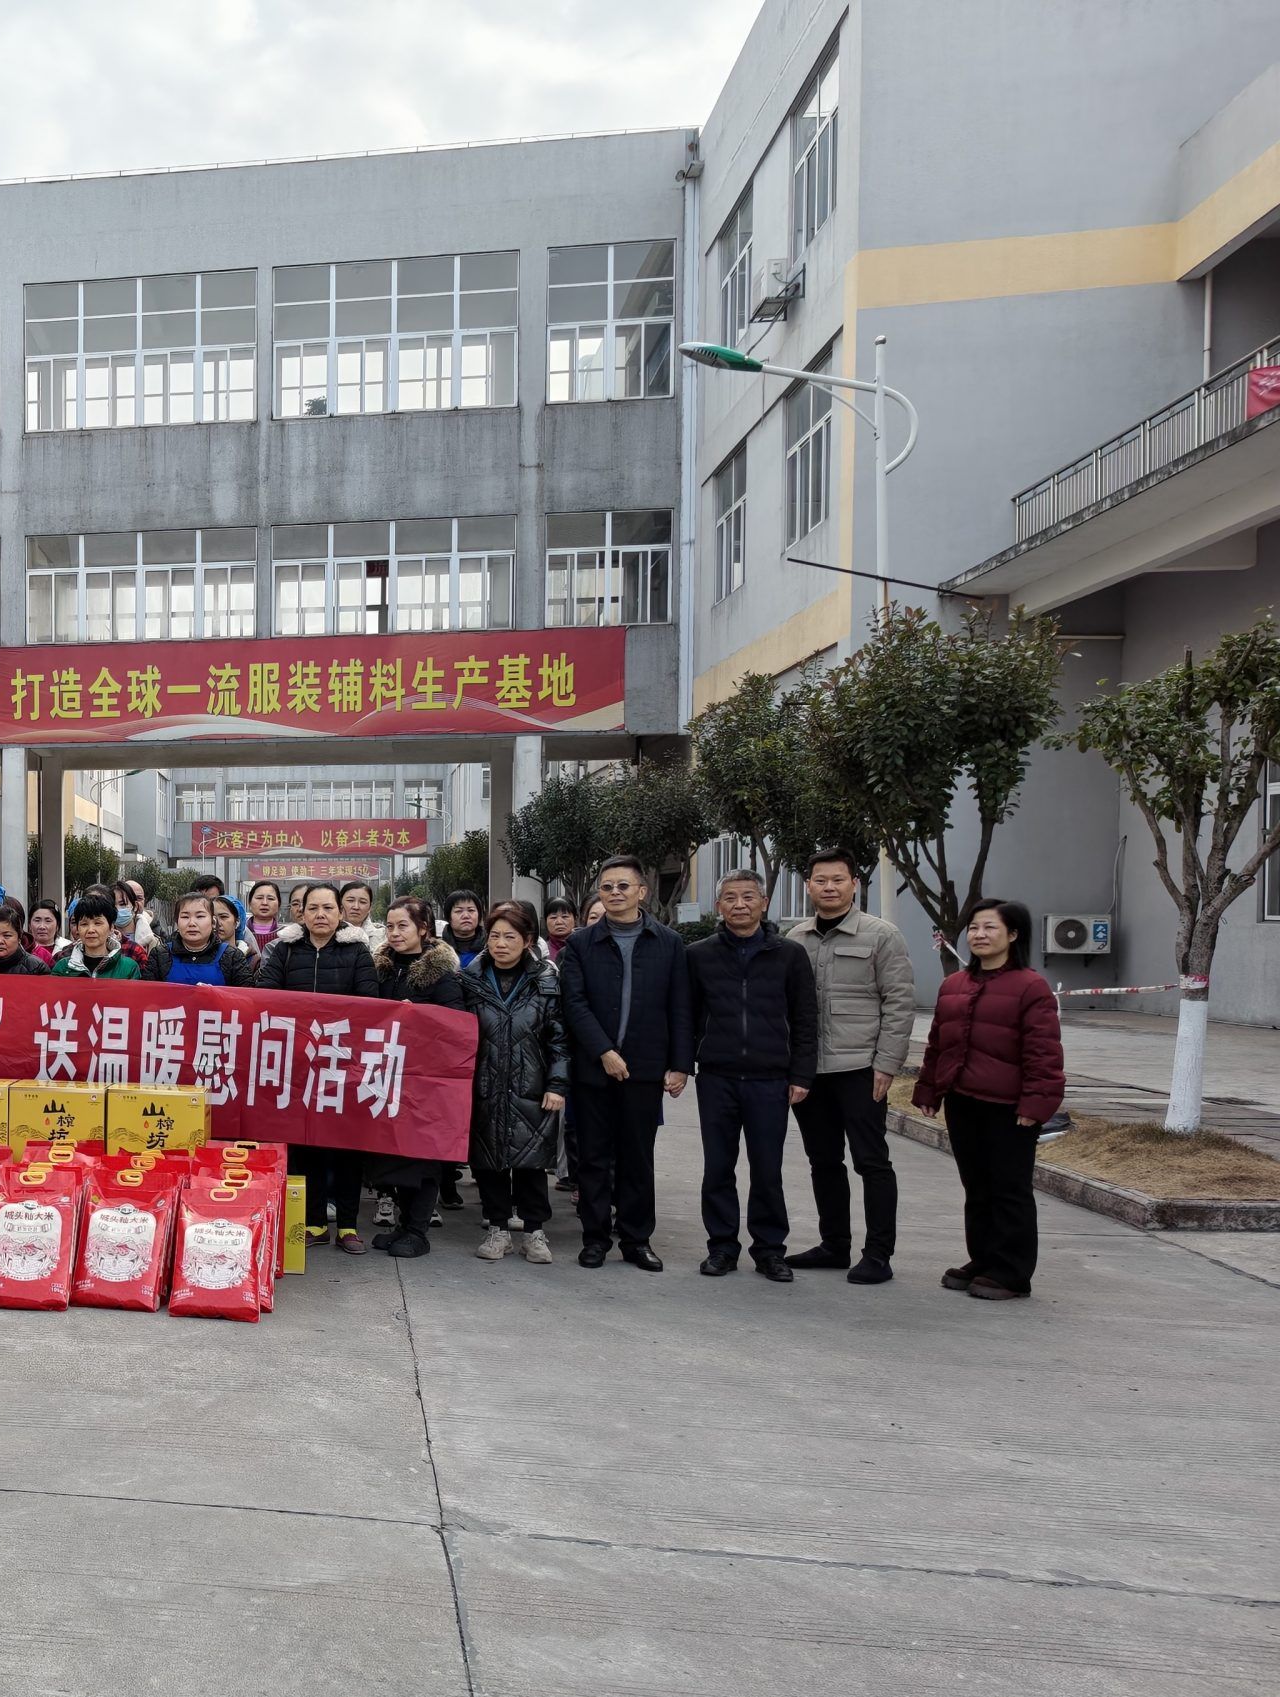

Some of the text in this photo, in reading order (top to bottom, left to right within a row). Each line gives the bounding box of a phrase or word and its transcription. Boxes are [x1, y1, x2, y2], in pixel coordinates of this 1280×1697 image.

[11, 653, 577, 721] 打造全球一流服装辅料生产基地
[216, 828, 410, 849] 以客户为中心 以奋斗者为本
[33, 1000, 407, 1119] 送温暖慰问活动
